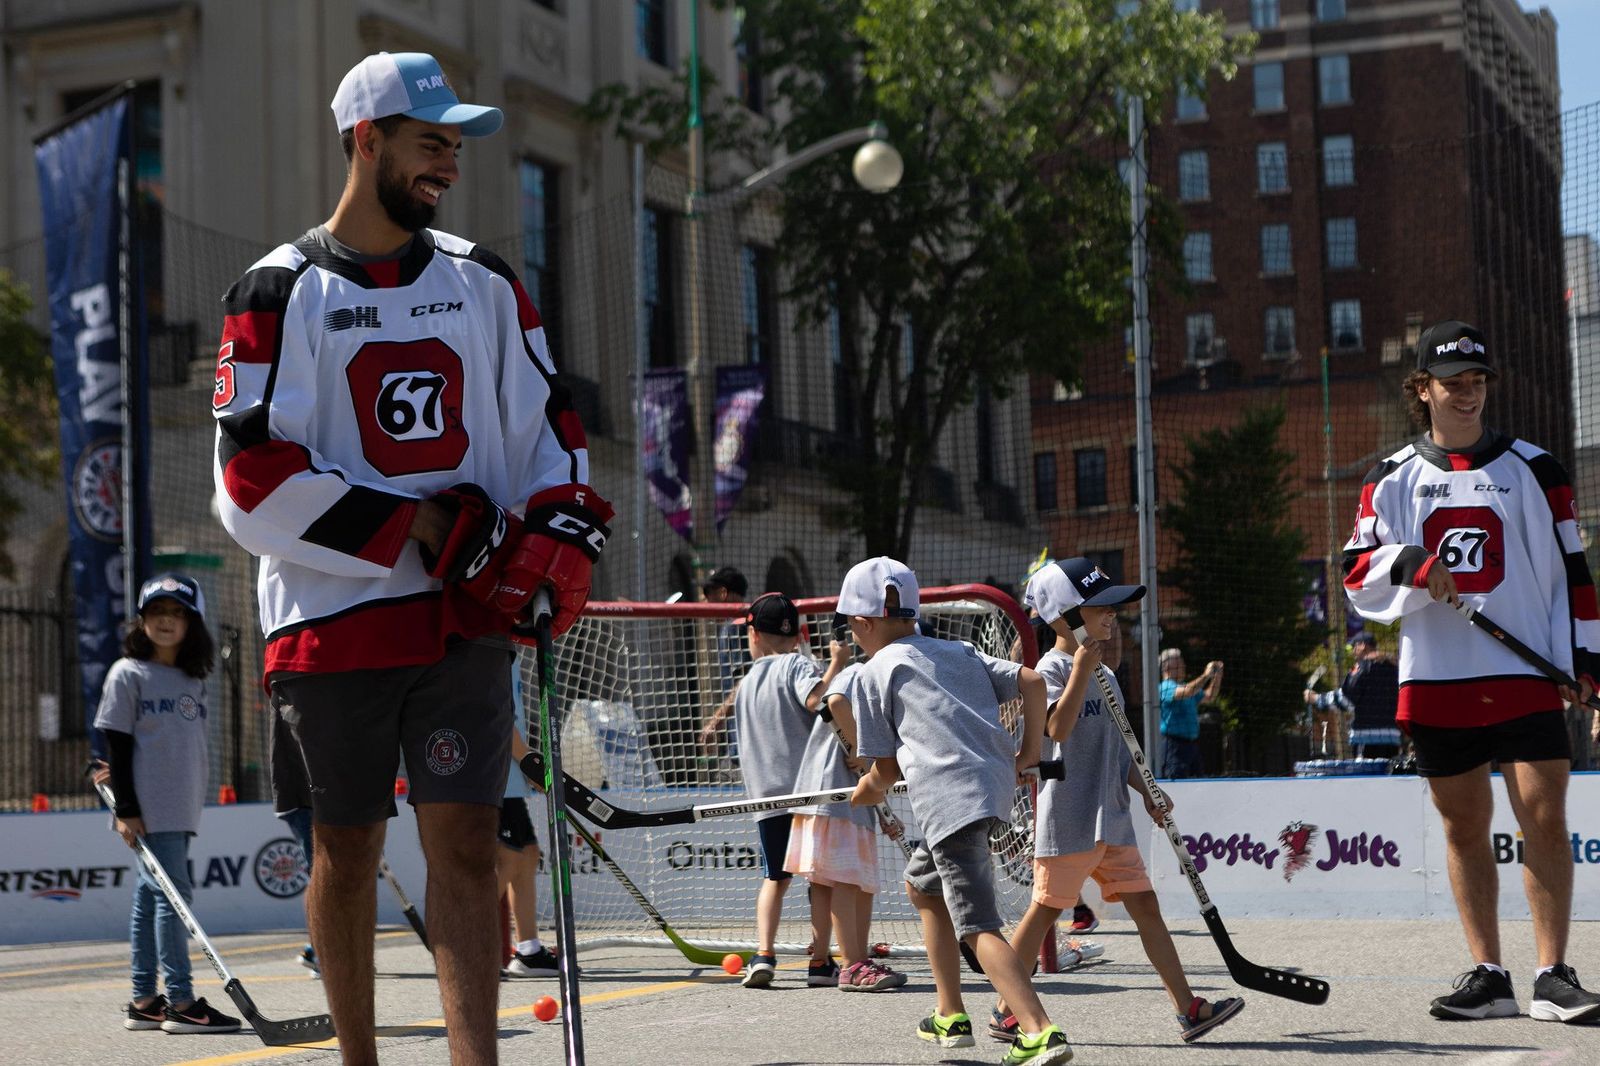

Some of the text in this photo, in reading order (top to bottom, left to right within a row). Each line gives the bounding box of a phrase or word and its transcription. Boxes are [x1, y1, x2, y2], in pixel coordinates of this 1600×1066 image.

[410, 301, 463, 317] CCM
[1436, 341, 1458, 356] PLAY
[1474, 484, 1510, 494] CCM
[575, 491, 586, 506] 5
[1143, 768, 1162, 799] STREET
[732, 802, 777, 814] STREET
[667, 841, 764, 870] Onta
[1316, 829, 1401, 871] Juice
